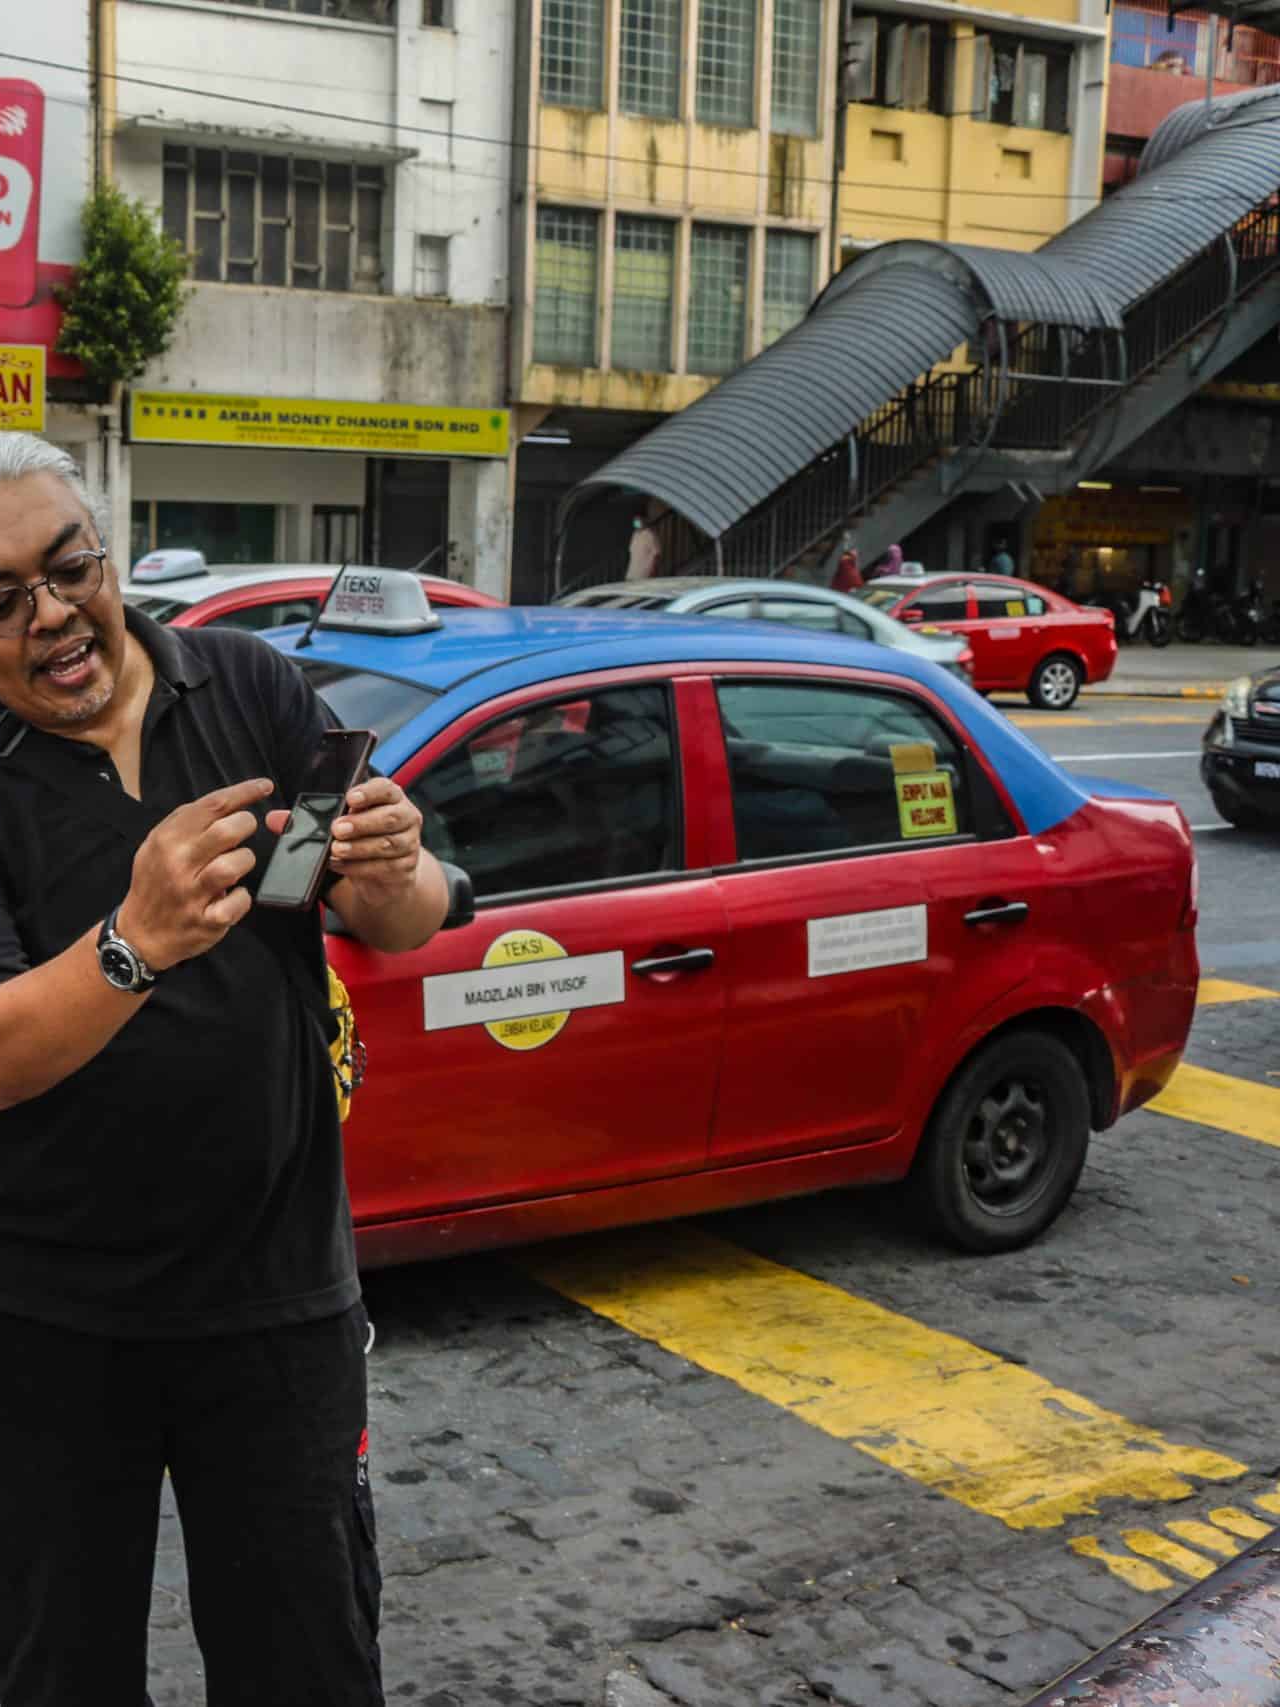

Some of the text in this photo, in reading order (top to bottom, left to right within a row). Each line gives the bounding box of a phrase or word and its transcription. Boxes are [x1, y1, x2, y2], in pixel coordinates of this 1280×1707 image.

[218, 409, 273, 422] AKBAR
[278, 411, 331, 425] MONEY
[336, 415, 410, 430] CHANGER
[414, 419, 444, 432] SDN
[448, 421, 480, 433] BHD
[343, 575, 383, 594] TEKSI
[500, 938, 545, 958] TEKSI
[464, 974, 588, 1005] MADZLAN BIN YUSOF
